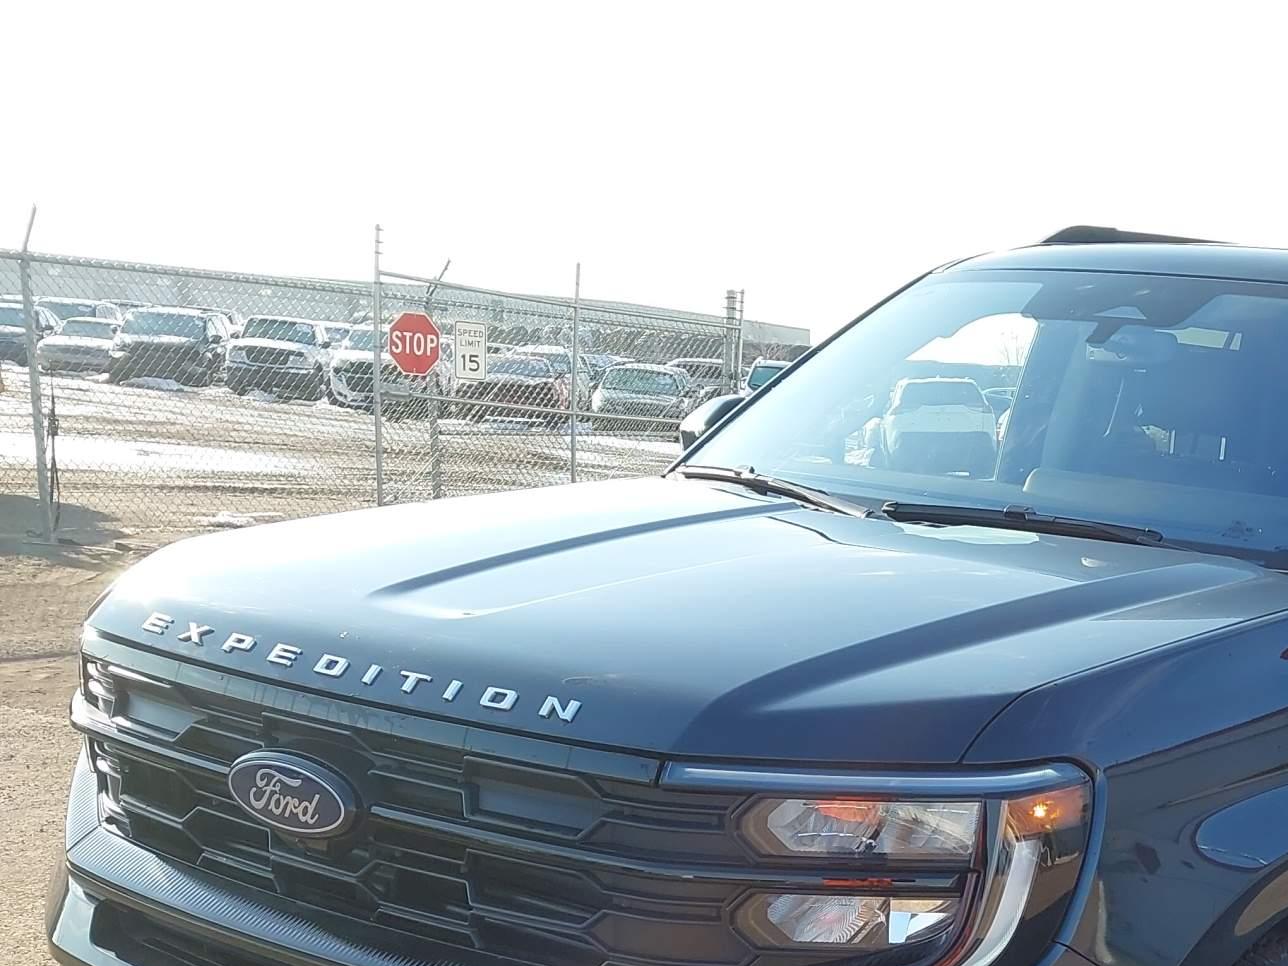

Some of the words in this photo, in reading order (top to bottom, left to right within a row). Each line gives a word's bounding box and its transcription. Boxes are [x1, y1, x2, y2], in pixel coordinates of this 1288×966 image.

[392, 331, 437, 356] STOP
[457, 328, 483, 338] SPEED
[460, 340, 480, 348] LIMIT
[461, 354, 480, 371] 15
[141, 611, 582, 724] EXPEDITION
[249, 768, 319, 826] Ford
